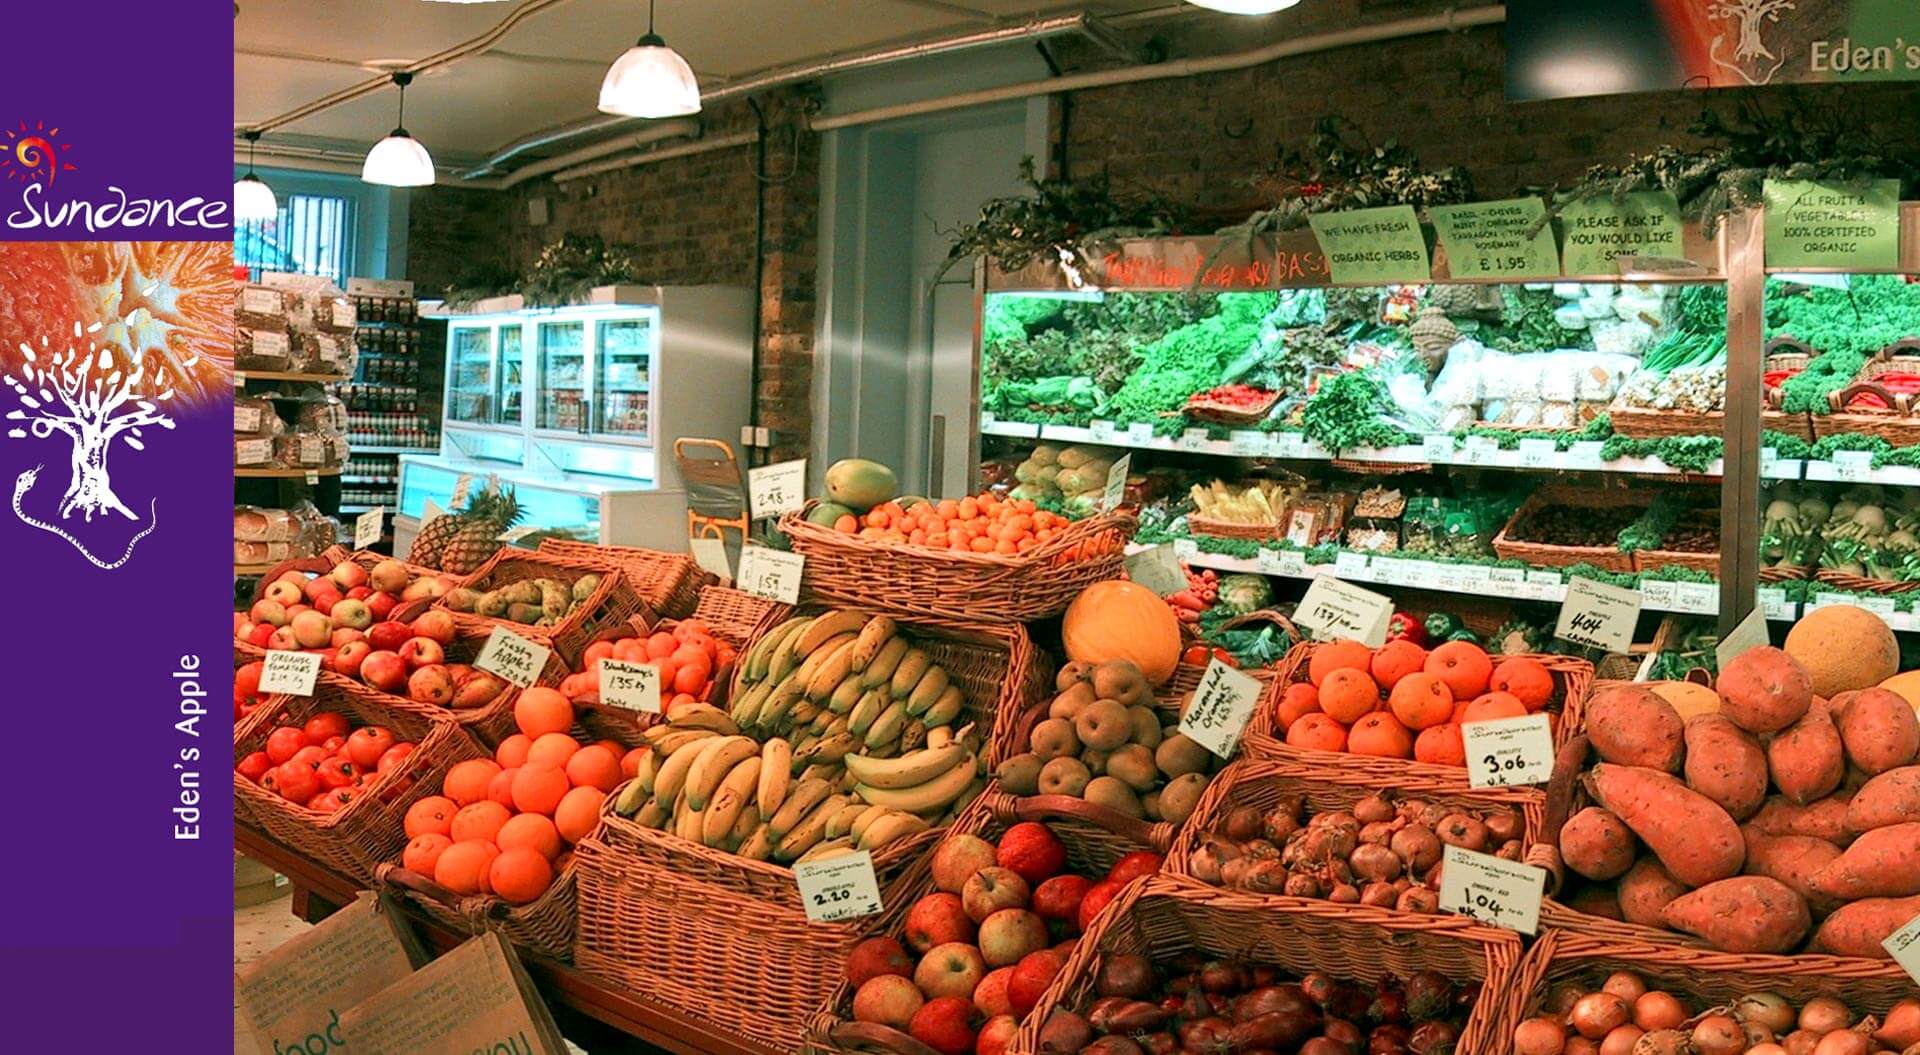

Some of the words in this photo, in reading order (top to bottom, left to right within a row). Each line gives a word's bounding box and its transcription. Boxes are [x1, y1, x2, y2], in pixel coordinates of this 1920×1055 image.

[1796, 196, 1813, 206] ALL
[1818, 195, 1855, 206] FRUIT
[1577, 216, 1618, 228] PLEASE
[1623, 215, 1647, 227] ASK
[1650, 214, 1664, 226] IF
[1323, 227, 1338, 238] WE
[1343, 224, 1372, 235] HAVE
[1374, 222, 1410, 232] FRESH
[1784, 228, 1811, 238] 100%
[1814, 227, 1876, 237] CERTIFIED
[1571, 233, 1595, 245] YOU
[1598, 232, 1642, 244] WOULD
[1646, 231, 1673, 243] LIKE
[1803, 242, 1857, 252] ORGANIC
[1331, 251, 1382, 263] ORGANIC
[1385, 250, 1421, 262] HERBS
[1480, 258, 1490, 271] £
[1496, 257, 1526, 270] 1.95
[1483, 754, 1526, 774] 3.06
[813, 889, 850, 906] 2.20
[1465, 887, 1504, 917] 1.04
